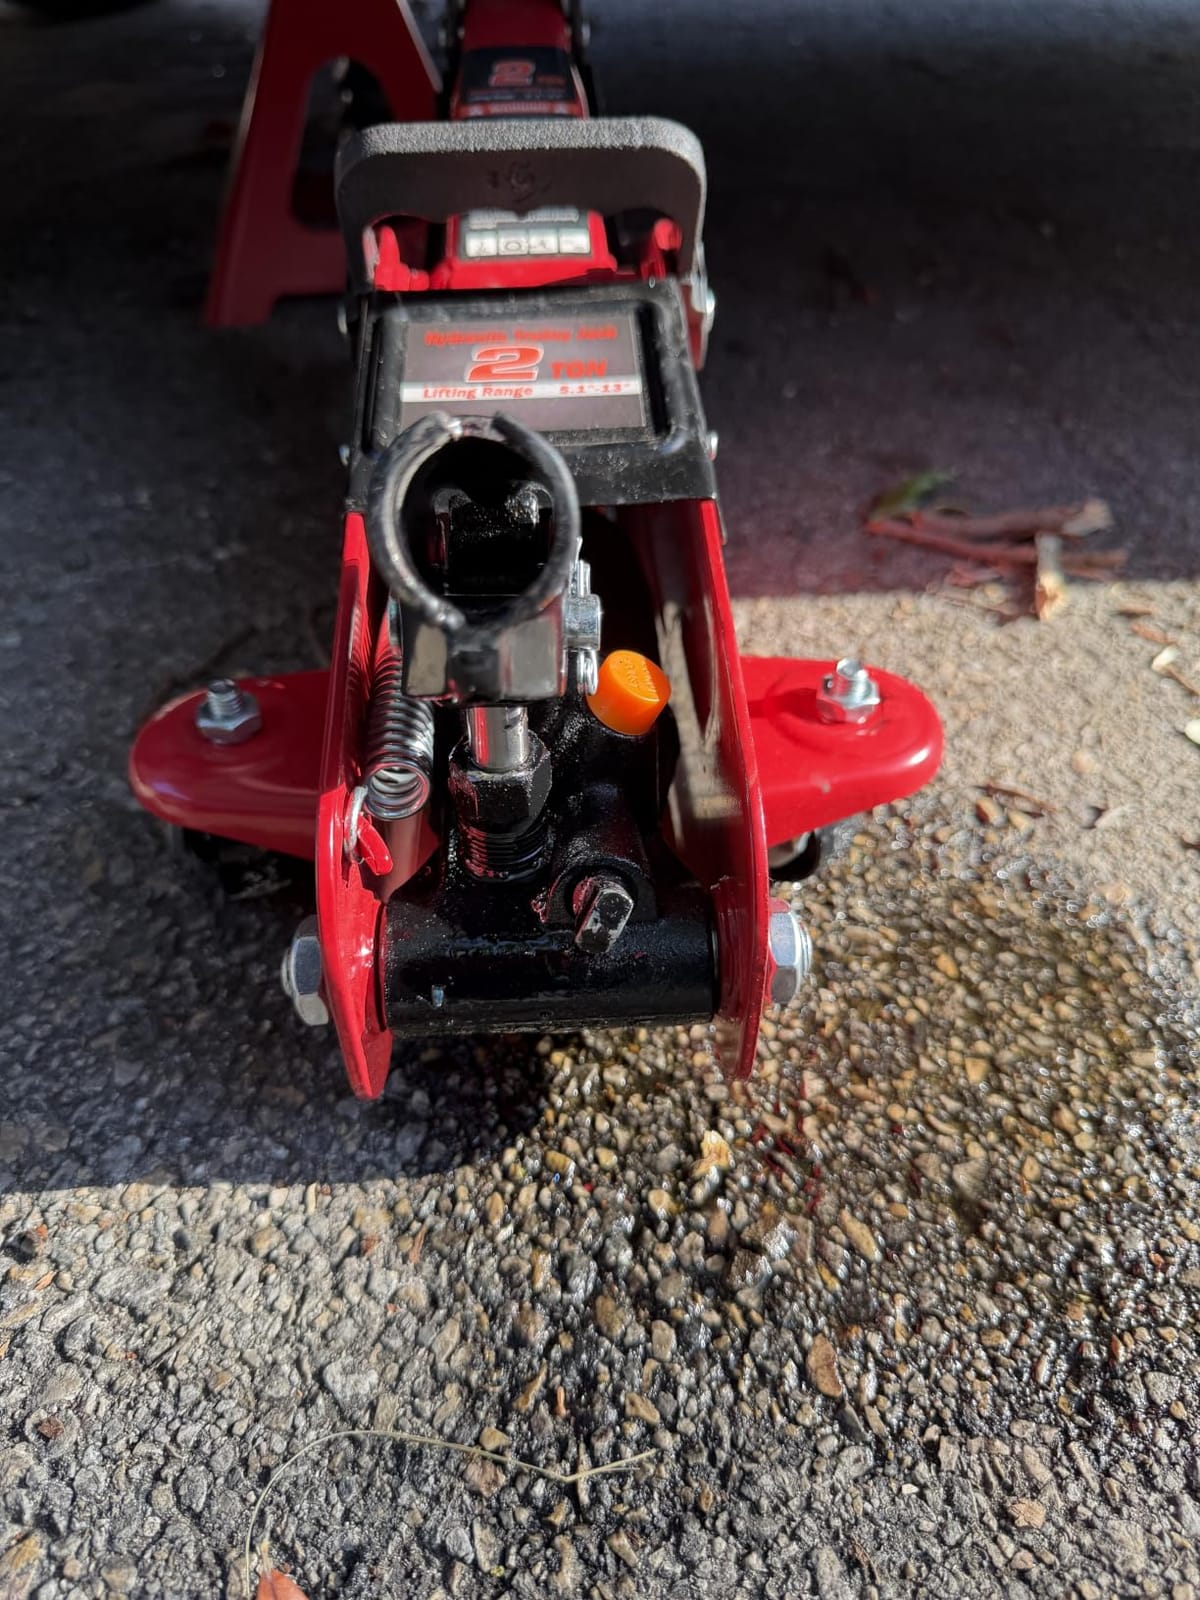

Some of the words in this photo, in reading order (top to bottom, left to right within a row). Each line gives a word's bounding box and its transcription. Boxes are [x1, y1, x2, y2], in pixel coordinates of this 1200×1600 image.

[464, 345, 544, 383] 2
[550, 359, 607, 379] TON
[423, 385, 476, 401] Lifting
[482, 384, 533, 400] Range
